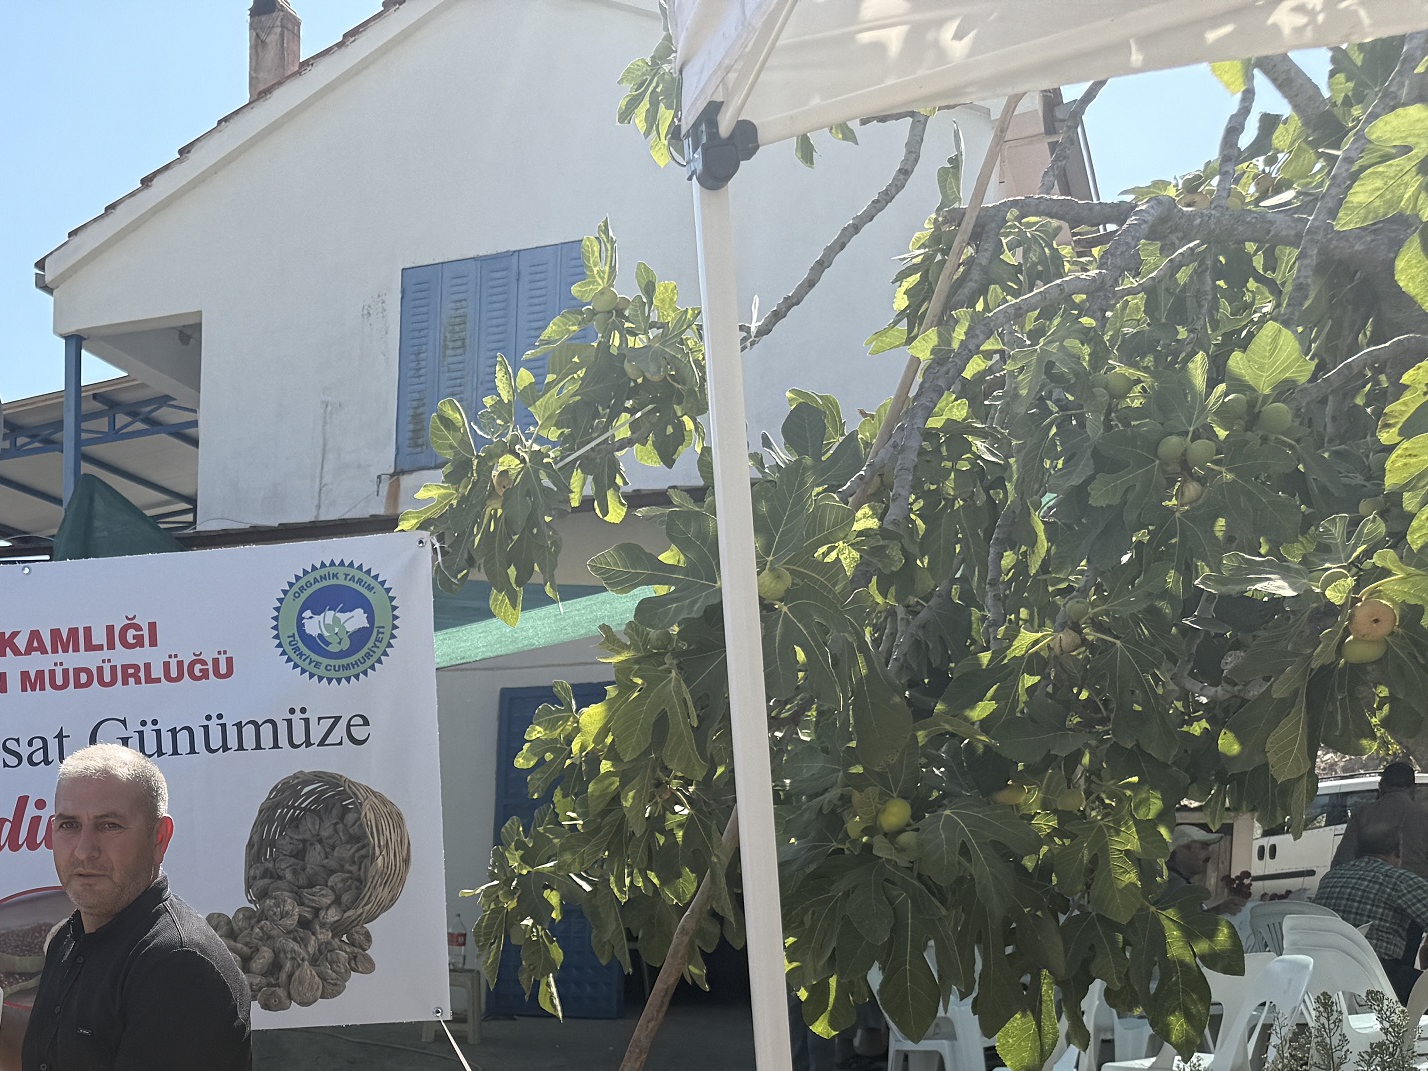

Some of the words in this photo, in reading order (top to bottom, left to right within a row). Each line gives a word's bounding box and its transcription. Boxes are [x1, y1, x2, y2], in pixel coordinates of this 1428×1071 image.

[20, 650, 234, 692] MÜDÜRLÜĞÜ
[287, 633, 322, 670] TÜRKİYE
[324, 625, 385, 672] CUMHURİYETİ
[88, 707, 371, 758] Günümüze
